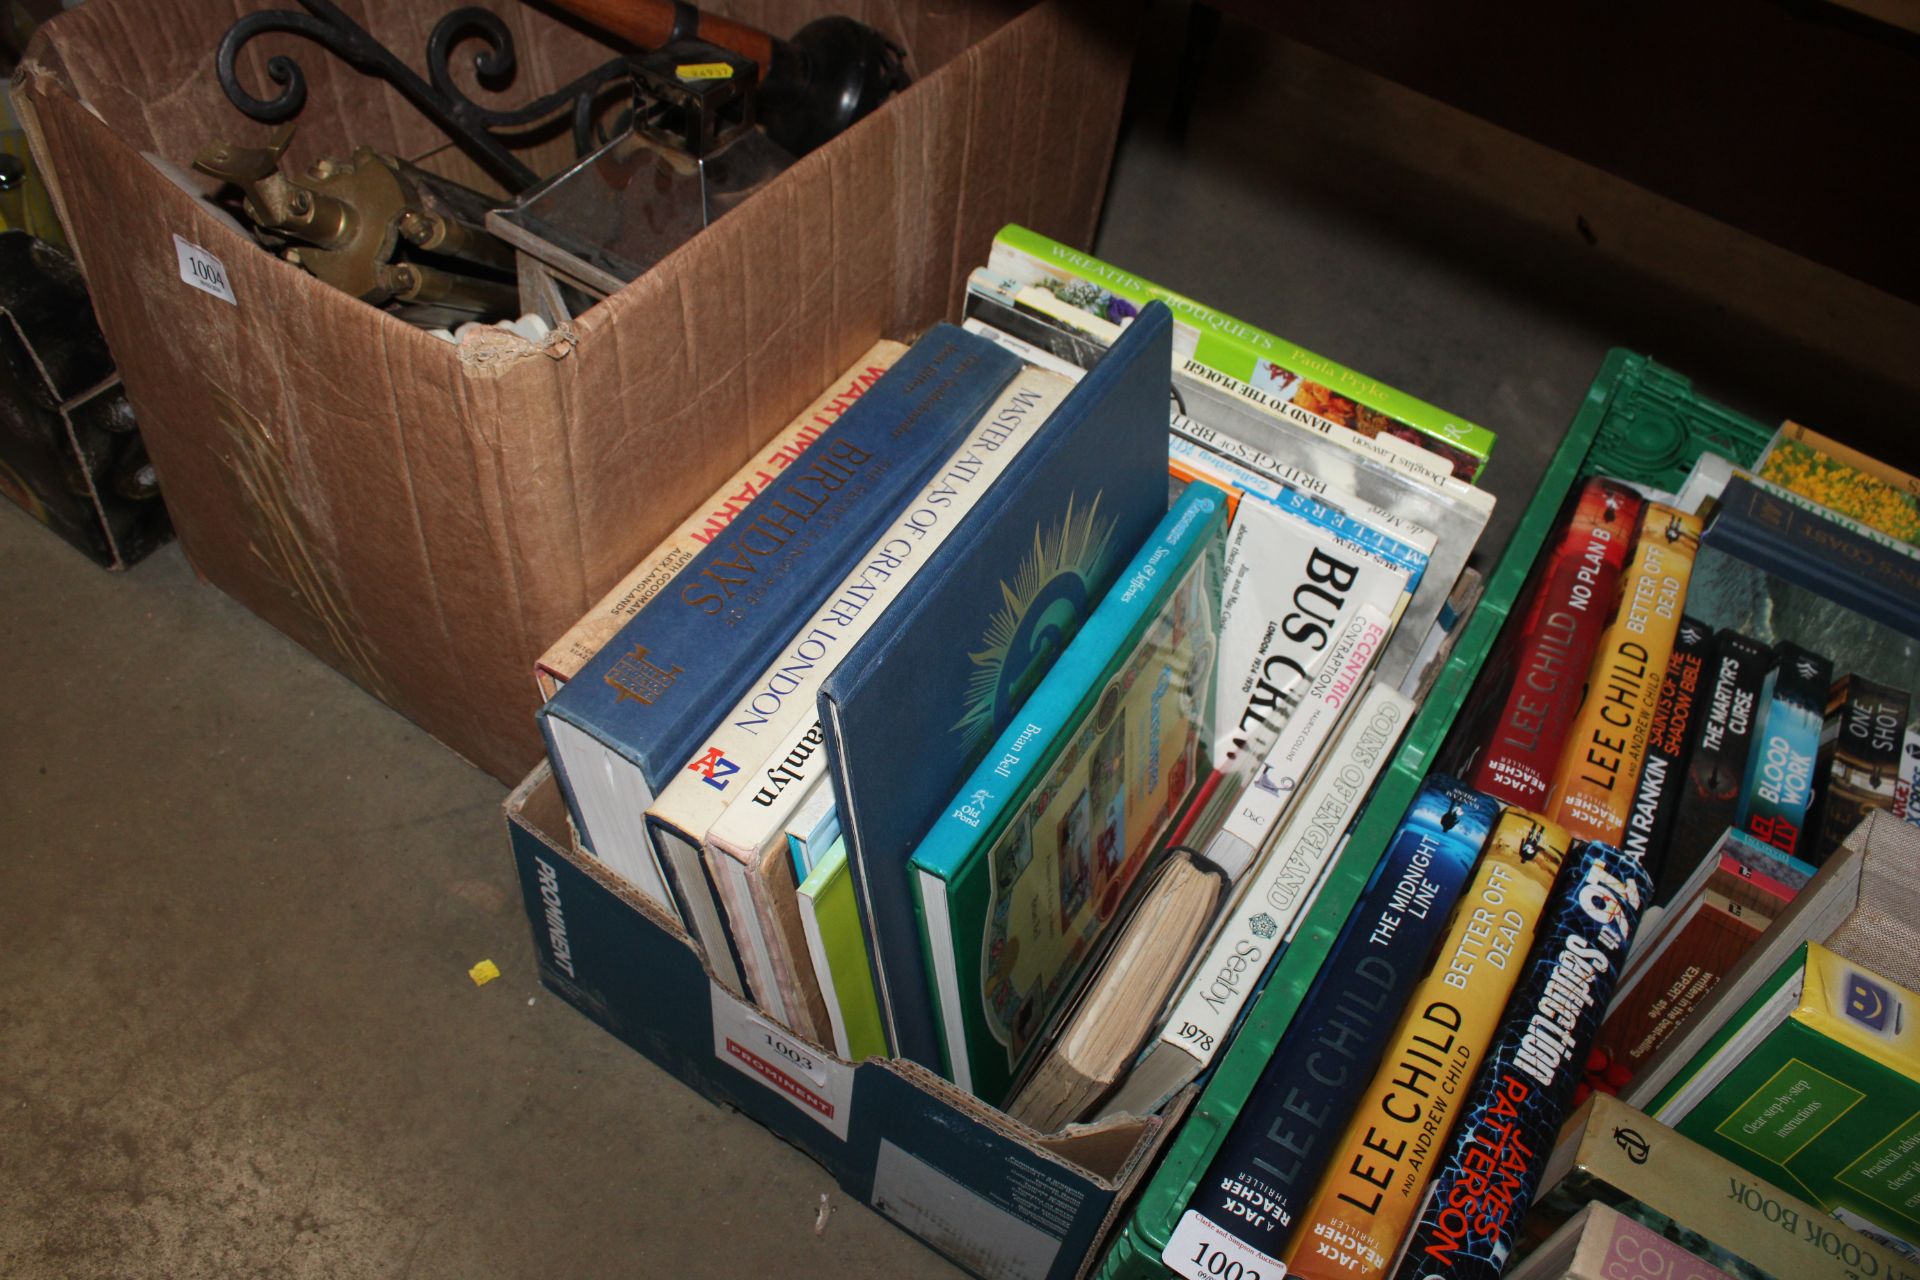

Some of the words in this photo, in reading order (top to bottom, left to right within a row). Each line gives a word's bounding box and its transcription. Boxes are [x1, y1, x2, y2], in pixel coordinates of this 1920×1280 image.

[188, 254, 226, 291] 1004
[1051, 246, 1142, 292] WREATHS
[1165, 294, 1274, 350] BOUQUETS
[1290, 349, 1335, 378] Paula
[1338, 365, 1390, 402] Pryke
[1182, 359, 1237, 393] PLOUGH
[1239, 384, 1268, 407] THE
[767, 366, 887, 469] WARTIME
[971, 387, 1044, 454] MASTER
[1170, 414, 1218, 444] BRIT
[1269, 396, 1290, 414] TO
[1290, 404, 1333, 435] HAND
[1219, 439, 1238, 453] OF
[1239, 444, 1329, 496] BRIDGES
[923, 452, 988, 511] ATLAS
[1398, 456, 1448, 489] Douglas
[680, 437, 873, 617] BIRTHDAYS
[690, 470, 776, 544] FARM
[906, 508, 939, 541] OF
[656, 546, 682, 572] ALEX
[670, 552, 693, 579] RUTH
[821, 537, 912, 628] GREATER
[1568, 580, 1593, 612] NO
[1584, 543, 1608, 586] PLAN
[1598, 529, 1612, 543] B
[610, 569, 659, 617] LANGLANDS
[625, 570, 672, 616] GOODMAN
[1281, 547, 1360, 652] BUS
[1626, 577, 1658, 635] BETTER
[1643, 544, 1667, 578] OFF
[1655, 576, 1682, 620] DEAD
[1258, 620, 1278, 656] LONDON
[1310, 616, 1368, 699] CONTRAPTIONS
[1526, 611, 1577, 693] CHILD
[733, 628, 838, 736] LONDON
[1324, 623, 1385, 710] ECCENTRIC
[1600, 641, 1649, 729] CHILD
[1662, 674, 1678, 696] OF
[1667, 650, 1686, 677] THE
[1504, 695, 1549, 753] LEE
[1632, 707, 1652, 762] ANDREW
[1643, 671, 1661, 708] CHILD
[1649, 695, 1673, 749] SAINTS
[1663, 700, 1691, 759] SHADOW
[1681, 652, 1703, 702] BIBLE
[1728, 687, 1755, 736] CURSE
[1848, 698, 1875, 739] ONE
[1871, 702, 1900, 753] SHOT
[1008, 723, 1042, 757] Brian
[1352, 701, 1401, 771] COINS
[1581, 729, 1626, 792] LEE
[1703, 724, 1724, 752] THE
[751, 718, 827, 809] amlyn
[993, 749, 1020, 779] Bell
[1336, 763, 1365, 803] OF
[1488, 760, 1547, 792] REACHER
[1494, 773, 1528, 792] JACK
[1757, 735, 1791, 806] BLOOD
[1780, 750, 1812, 807] WORK
[961, 803, 981, 820] Old
[1528, 787, 1536, 796] A
[1565, 795, 1624, 828] REACHER
[1639, 755, 1670, 830] RANKIN
[951, 809, 982, 829] Pond
[1570, 808, 1606, 828] JACK
[1265, 789, 1347, 912] ENGLAND
[1369, 911, 1401, 947] THE
[1390, 833, 1441, 913] MIDNIGHT
[1407, 881, 1441, 920] LINE
[535, 855, 576, 979] PROMINENT
[1443, 906, 1498, 991] BETTER
[1482, 865, 1516, 911] OFF
[1485, 909, 1525, 972] DEAD
[1199, 939, 1263, 1016] Seaby
[1511, 933, 1612, 1087] Seduction
[1648, 998, 1668, 1020] style
[1667, 1004, 1685, 1020] the
[764, 1033, 814, 1071] 1003
[1176, 1020, 1216, 1052] 1978
[732, 1043, 830, 1112] PROMINENT
[1252, 1086, 1331, 1186] LEE
[1306, 956, 1398, 1088] CHILD
[1337, 1125, 1408, 1216] LEE
[1382, 1000, 1462, 1125] CHILD
[1400, 1172, 1418, 1198] AND
[1410, 1096, 1450, 1172] ANDREW
[1440, 1044, 1472, 1099] CHILD
[1742, 1115, 1767, 1136] Clear
[1764, 1079, 1812, 1119] step-by-step
[1774, 1100, 1823, 1139] instructions
[1237, 1171, 1289, 1207] THRILLER
[1423, 1074, 1529, 1267] PATTERSON
[1474, 1131, 1535, 1246] JAMES
[1860, 1148, 1903, 1180] Practical
[1887, 1170, 1917, 1192] clever
[1219, 1176, 1292, 1229] REACHER
[1221, 1197, 1267, 1228] JACK
[1266, 1221, 1276, 1232] A
[1726, 1177, 1800, 1235] BOOK
[1194, 1213, 1215, 1229] Clarke
[1215, 1225, 1229, 1237] and
[1228, 1233, 1257, 1257] Simpson
[1254, 1251, 1285, 1271] Auctions
[1313, 1221, 1386, 1270] REACHER
[1314, 1241, 1358, 1272] JACK
[1329, 1216, 1381, 1250] THRILLER
[1804, 1218, 1879, 1278] COOK
[1360, 1262, 1370, 1275] A
